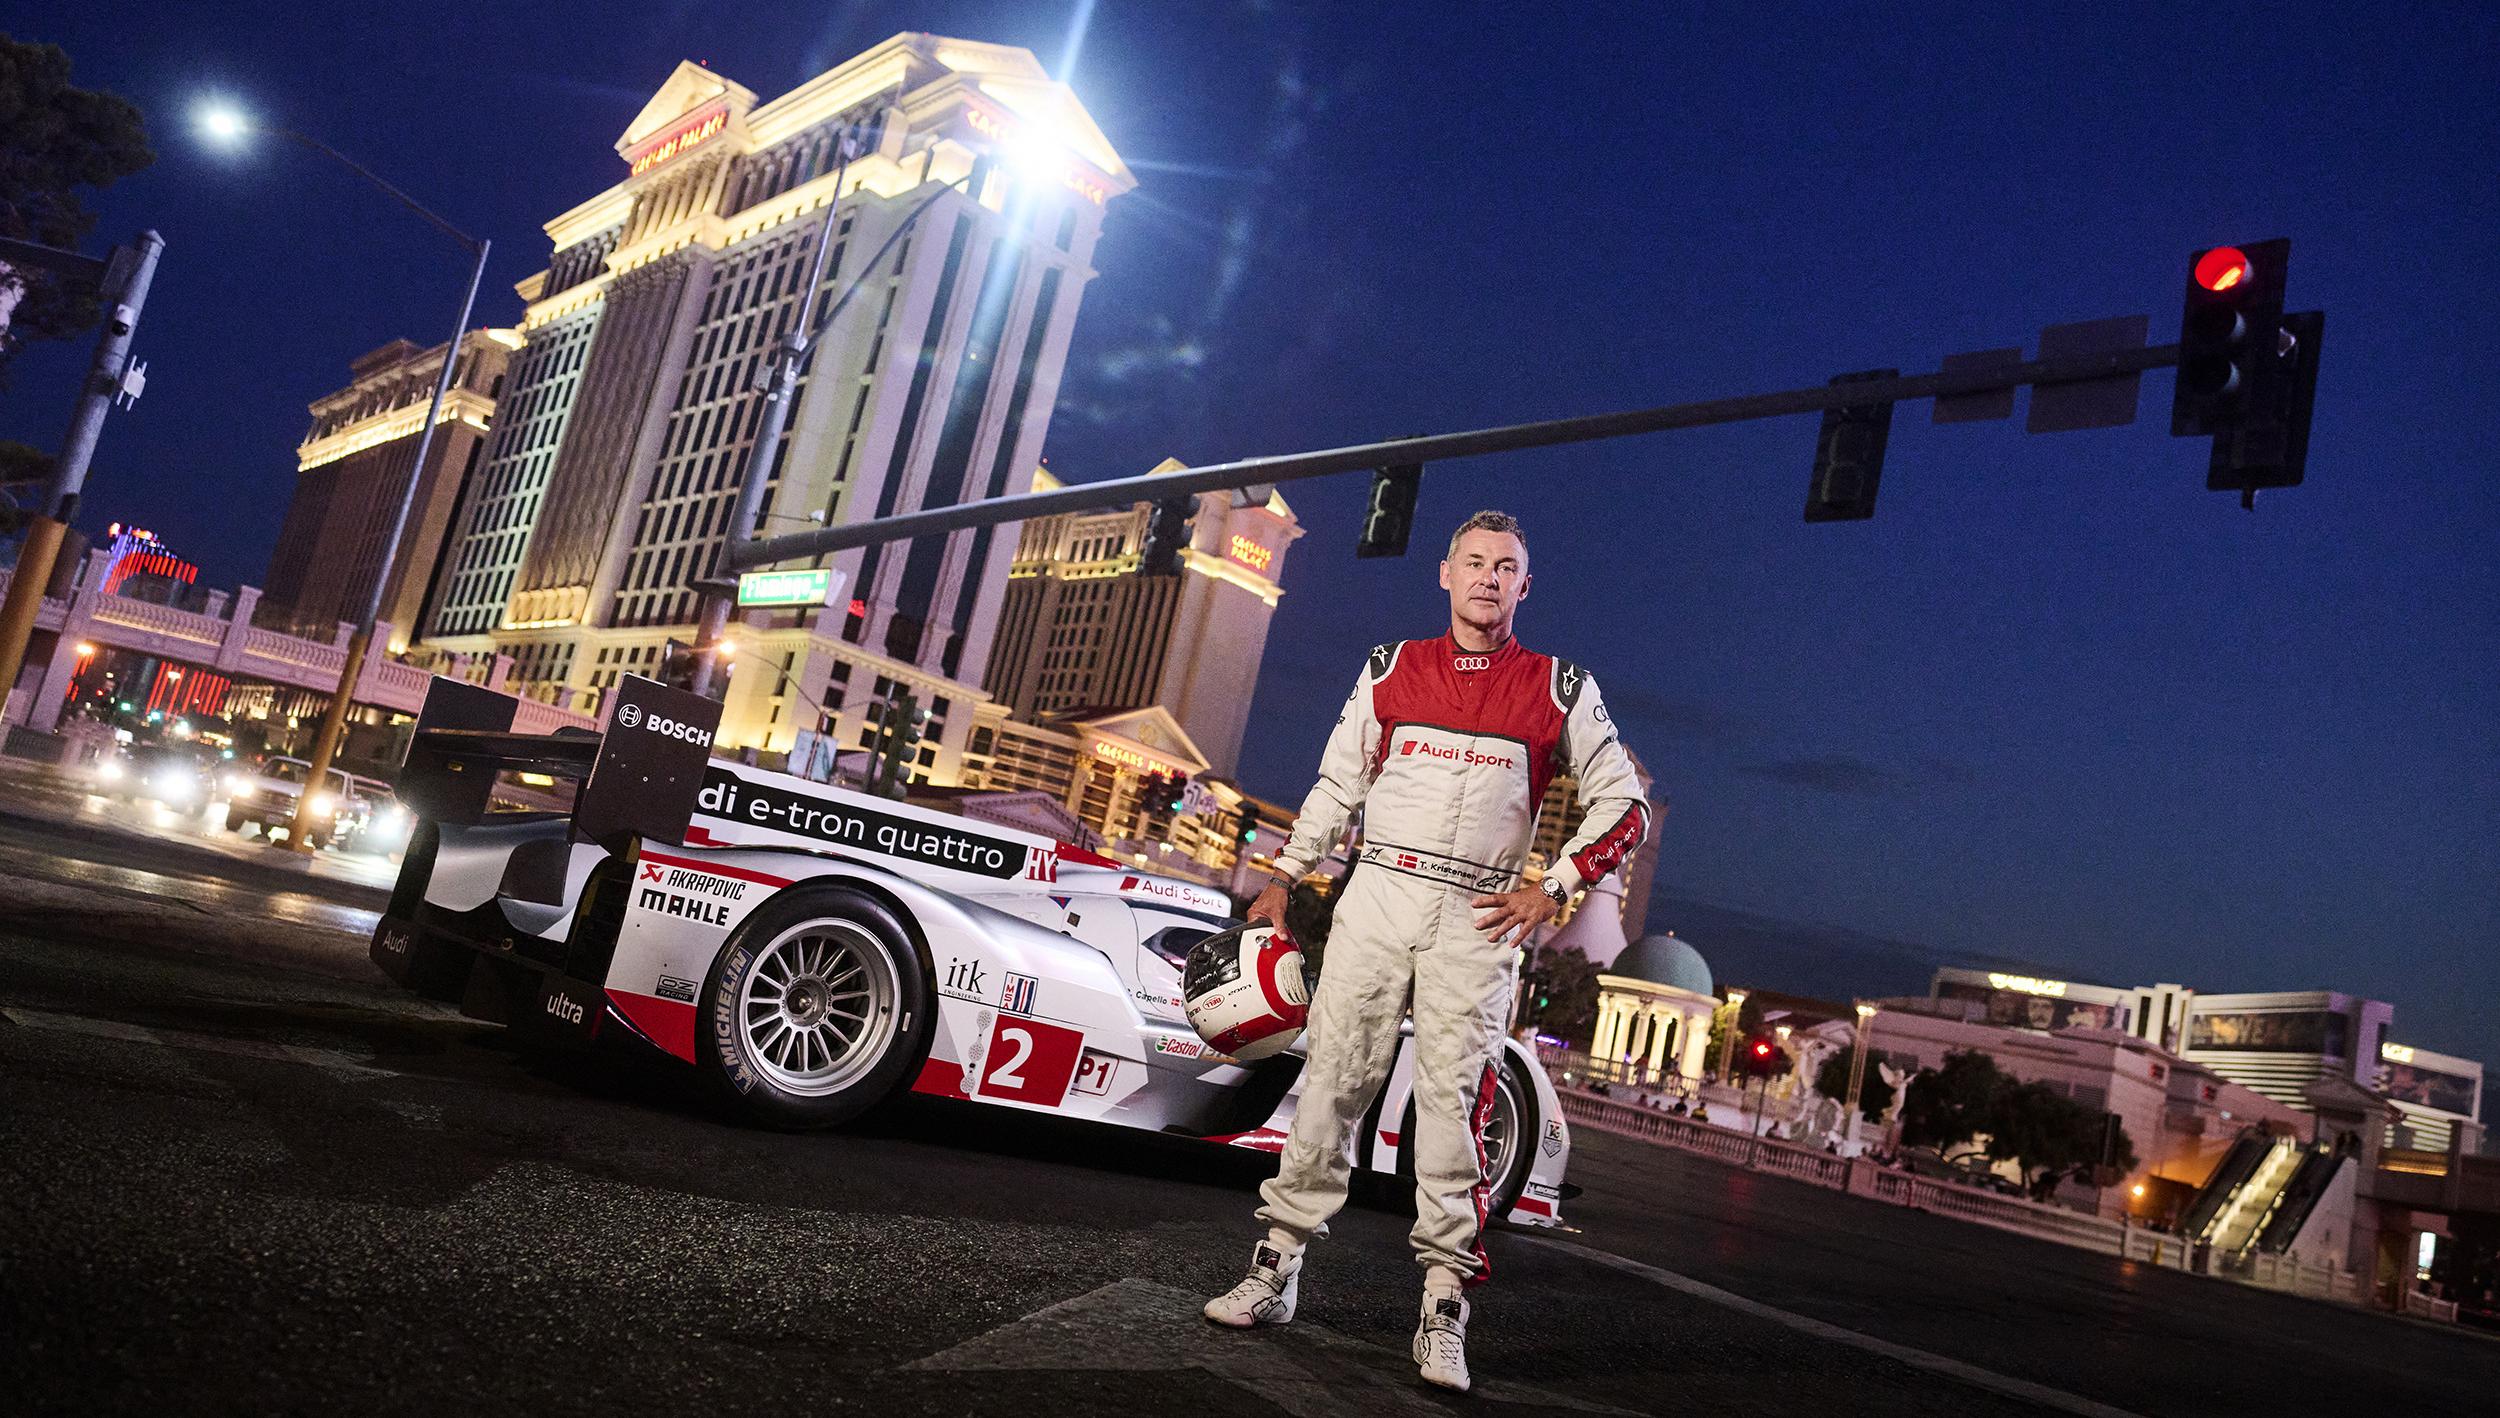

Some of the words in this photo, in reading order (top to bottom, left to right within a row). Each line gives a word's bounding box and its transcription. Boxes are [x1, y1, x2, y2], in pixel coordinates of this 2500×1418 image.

[646, 713, 712, 748] BOSCH
[1095, 742, 1144, 768] CAESARS
[1419, 742, 1459, 760] Audi
[1464, 750, 1513, 769] Sport
[749, 798, 864, 840] e-tron
[877, 825, 1004, 869] quattro
[1025, 847, 1058, 881] HY
[1594, 846, 1615, 863] Audi
[1419, 860, 1428, 870] T.
[1430, 862, 1477, 881] Kristensen
[1142, 880, 1178, 898] Audi
[639, 888, 730, 927] MAHLE
[382, 929, 409, 955] Audi
[945, 956, 987, 995] itk
[547, 992, 594, 1025] ultra
[660, 988, 690, 1001] RACING
[716, 950, 749, 1067] MICHELIN
[944, 989, 982, 1002] ENGINEERING
[988, 1027, 1034, 1089] 2
[1165, 1038, 1202, 1057] Castrol
[1073, 1056, 1111, 1089] P1
